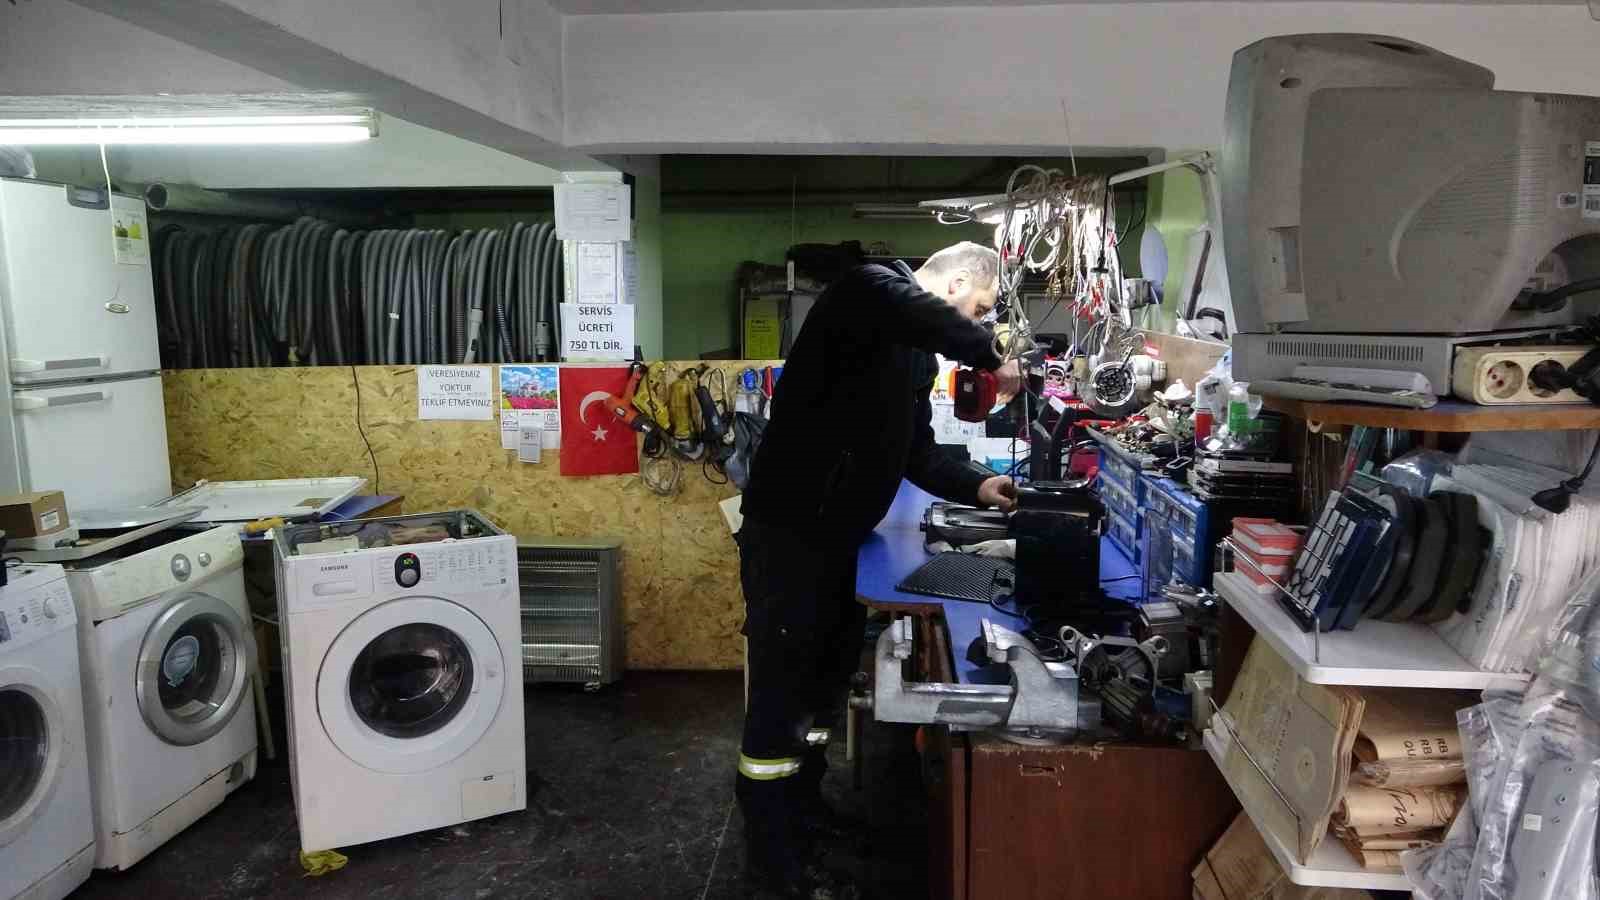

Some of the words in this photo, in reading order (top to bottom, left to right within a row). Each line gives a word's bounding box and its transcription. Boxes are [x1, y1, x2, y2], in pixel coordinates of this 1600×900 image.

[578, 305, 613, 316] SERVİS
[578, 320, 613, 332] ÜCRETİ
[569, 340, 588, 350] 750
[589, 340, 600, 350] TL
[439, 383, 473, 392] YOKTUR
